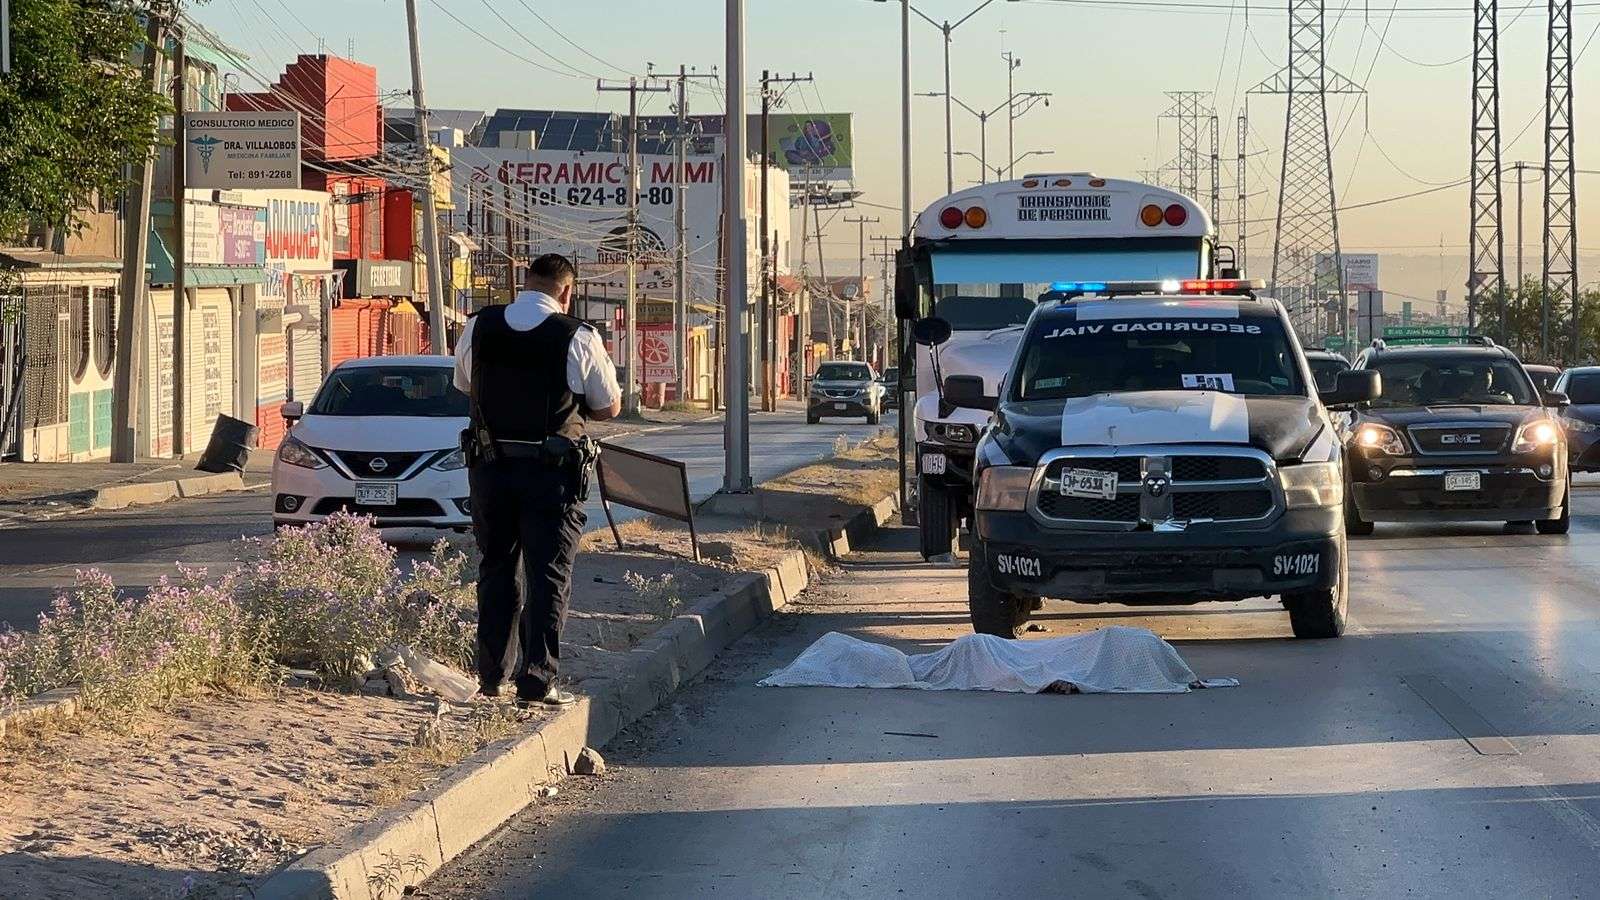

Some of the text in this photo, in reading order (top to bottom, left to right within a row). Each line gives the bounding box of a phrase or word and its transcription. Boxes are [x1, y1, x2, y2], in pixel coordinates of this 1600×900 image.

[190, 119, 294, 128] CONSULTORIO MEDICO
[224, 141, 296, 150] DRA. VILLALOBOS
[228, 170, 245, 179] Tel:
[497, 161, 714, 185] CERAMIC MMI
[529, 187, 562, 206] Tel.
[1018, 195, 1111, 208] TRANSPORTE
[1018, 208, 1111, 221] DE PERSONAL
[1441, 434, 1481, 444] GMC
[998, 554, 1041, 577] SV-1021
[1274, 554, 1320, 575] SV-1021
